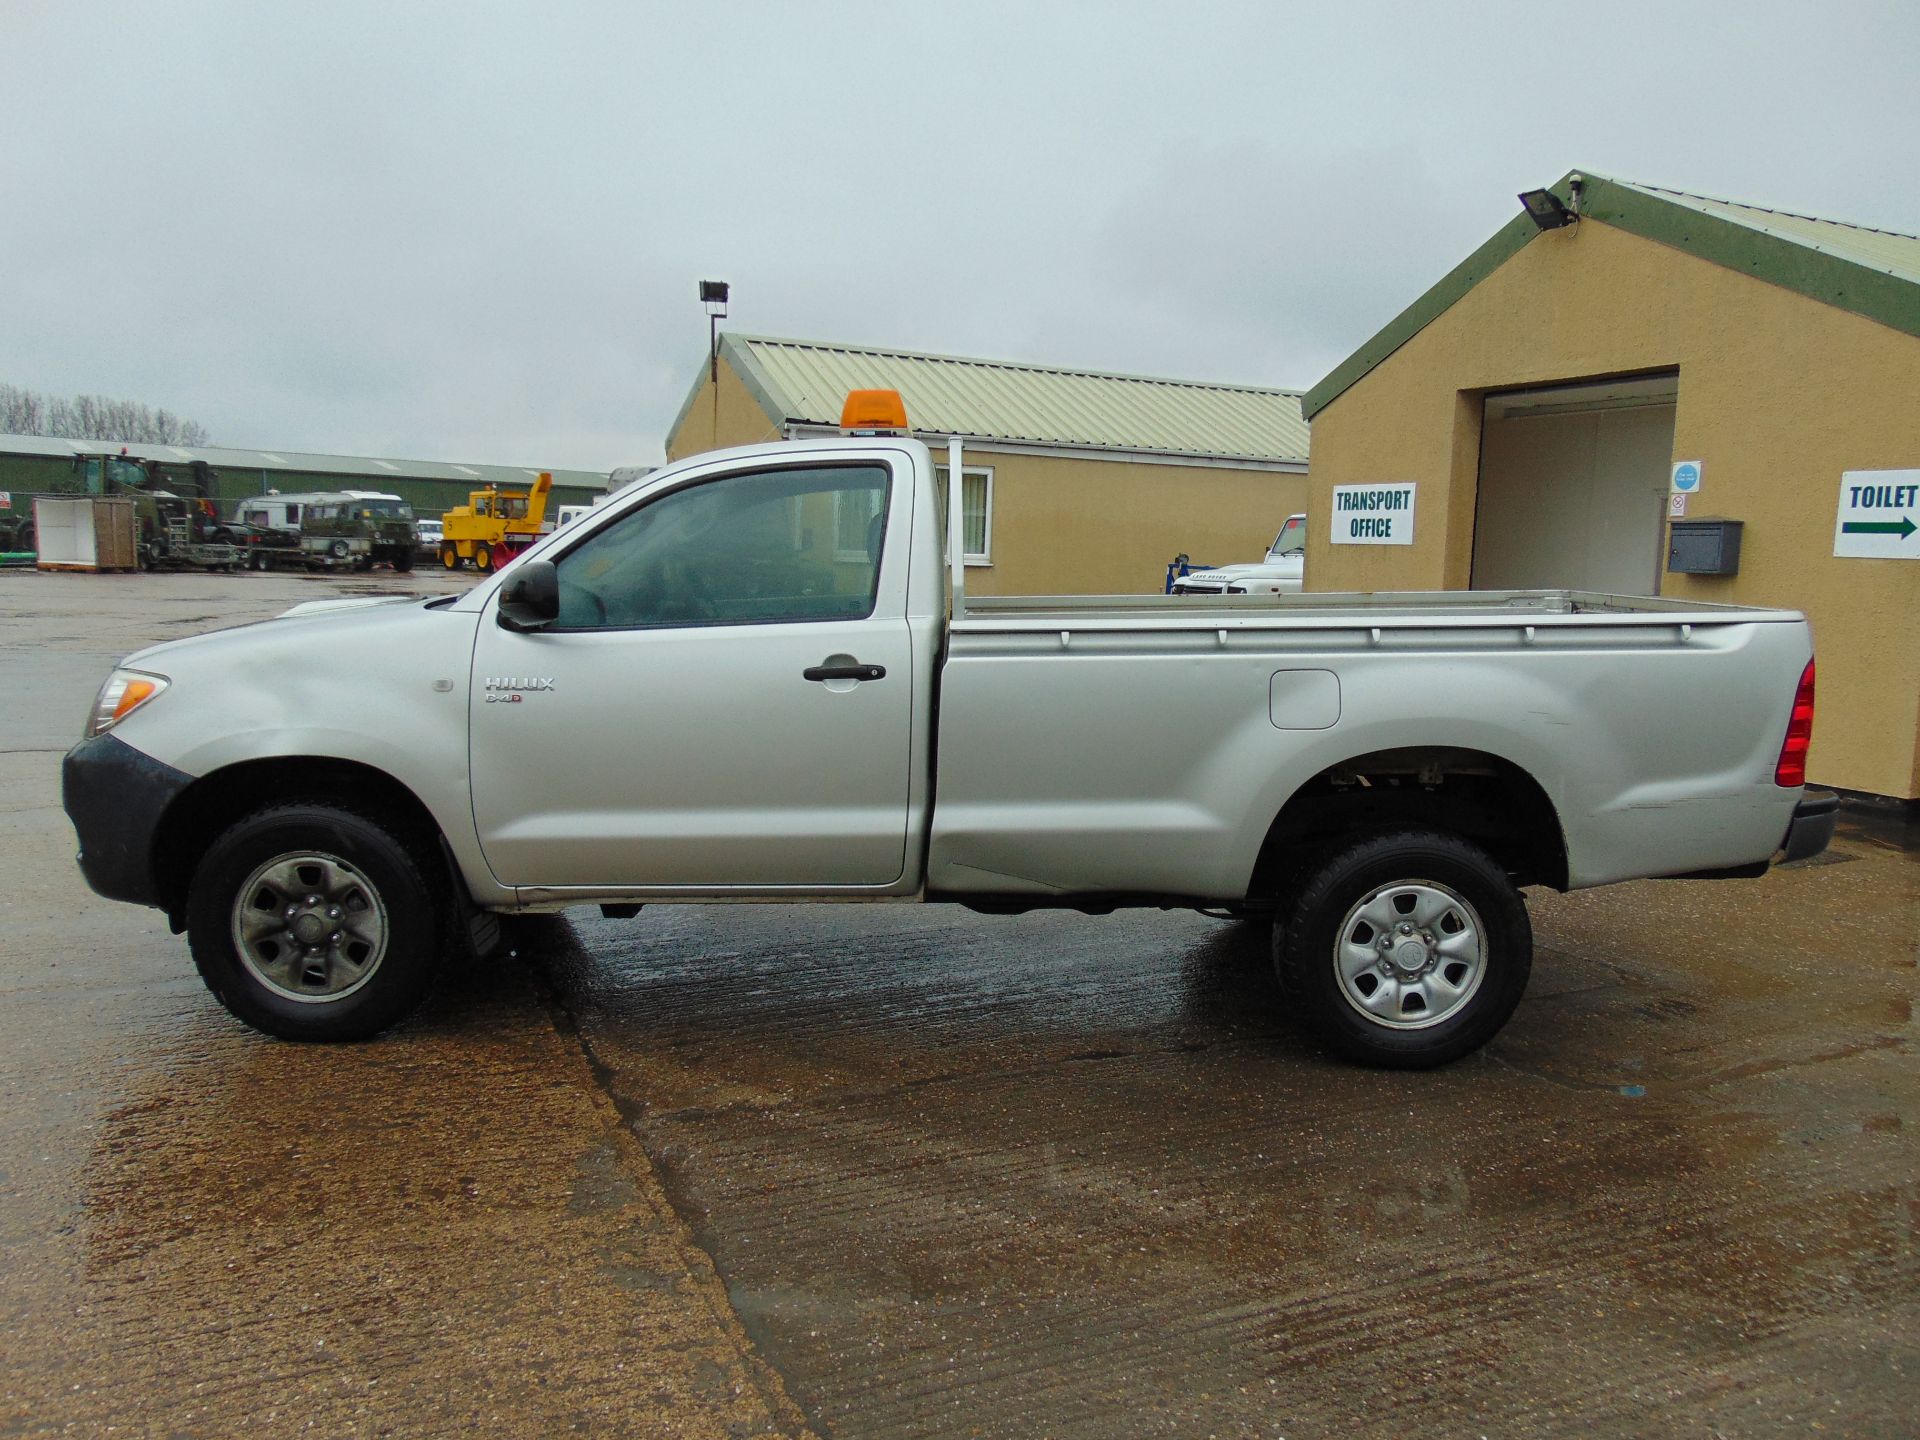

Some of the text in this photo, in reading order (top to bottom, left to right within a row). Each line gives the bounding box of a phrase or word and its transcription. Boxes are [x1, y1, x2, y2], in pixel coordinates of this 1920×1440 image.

[1336, 490, 1411, 511] TRANSPORT
[1850, 485, 1919, 508] TOILET
[1350, 518, 1392, 537] OFFICE
[486, 677, 554, 691] HILUX
